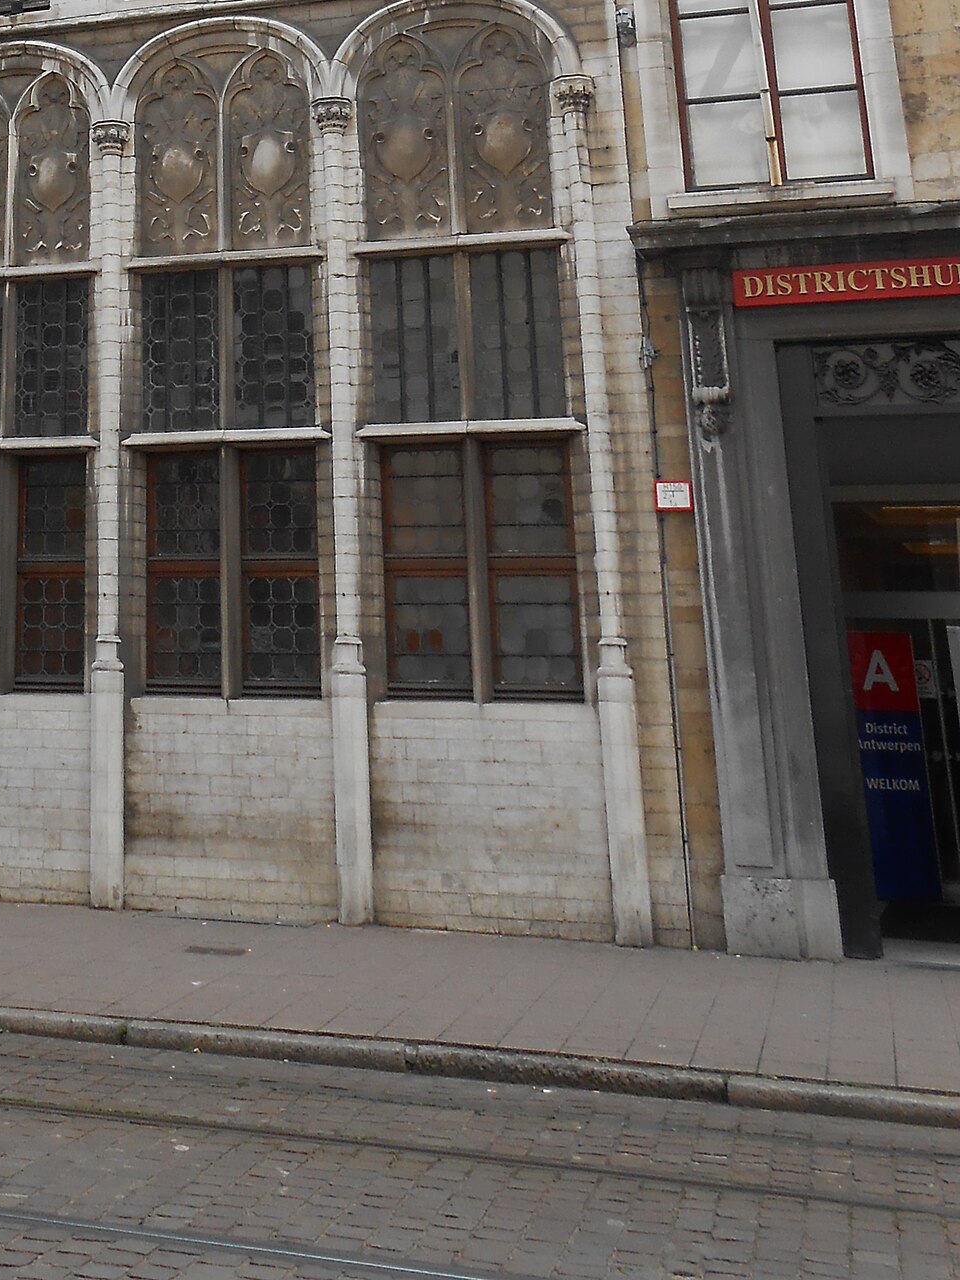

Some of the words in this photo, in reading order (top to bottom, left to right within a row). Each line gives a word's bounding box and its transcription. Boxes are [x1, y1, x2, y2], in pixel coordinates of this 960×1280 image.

[863, 649, 900, 692] A
[865, 722, 909, 735] District
[866, 777, 921, 791] WELKOM
